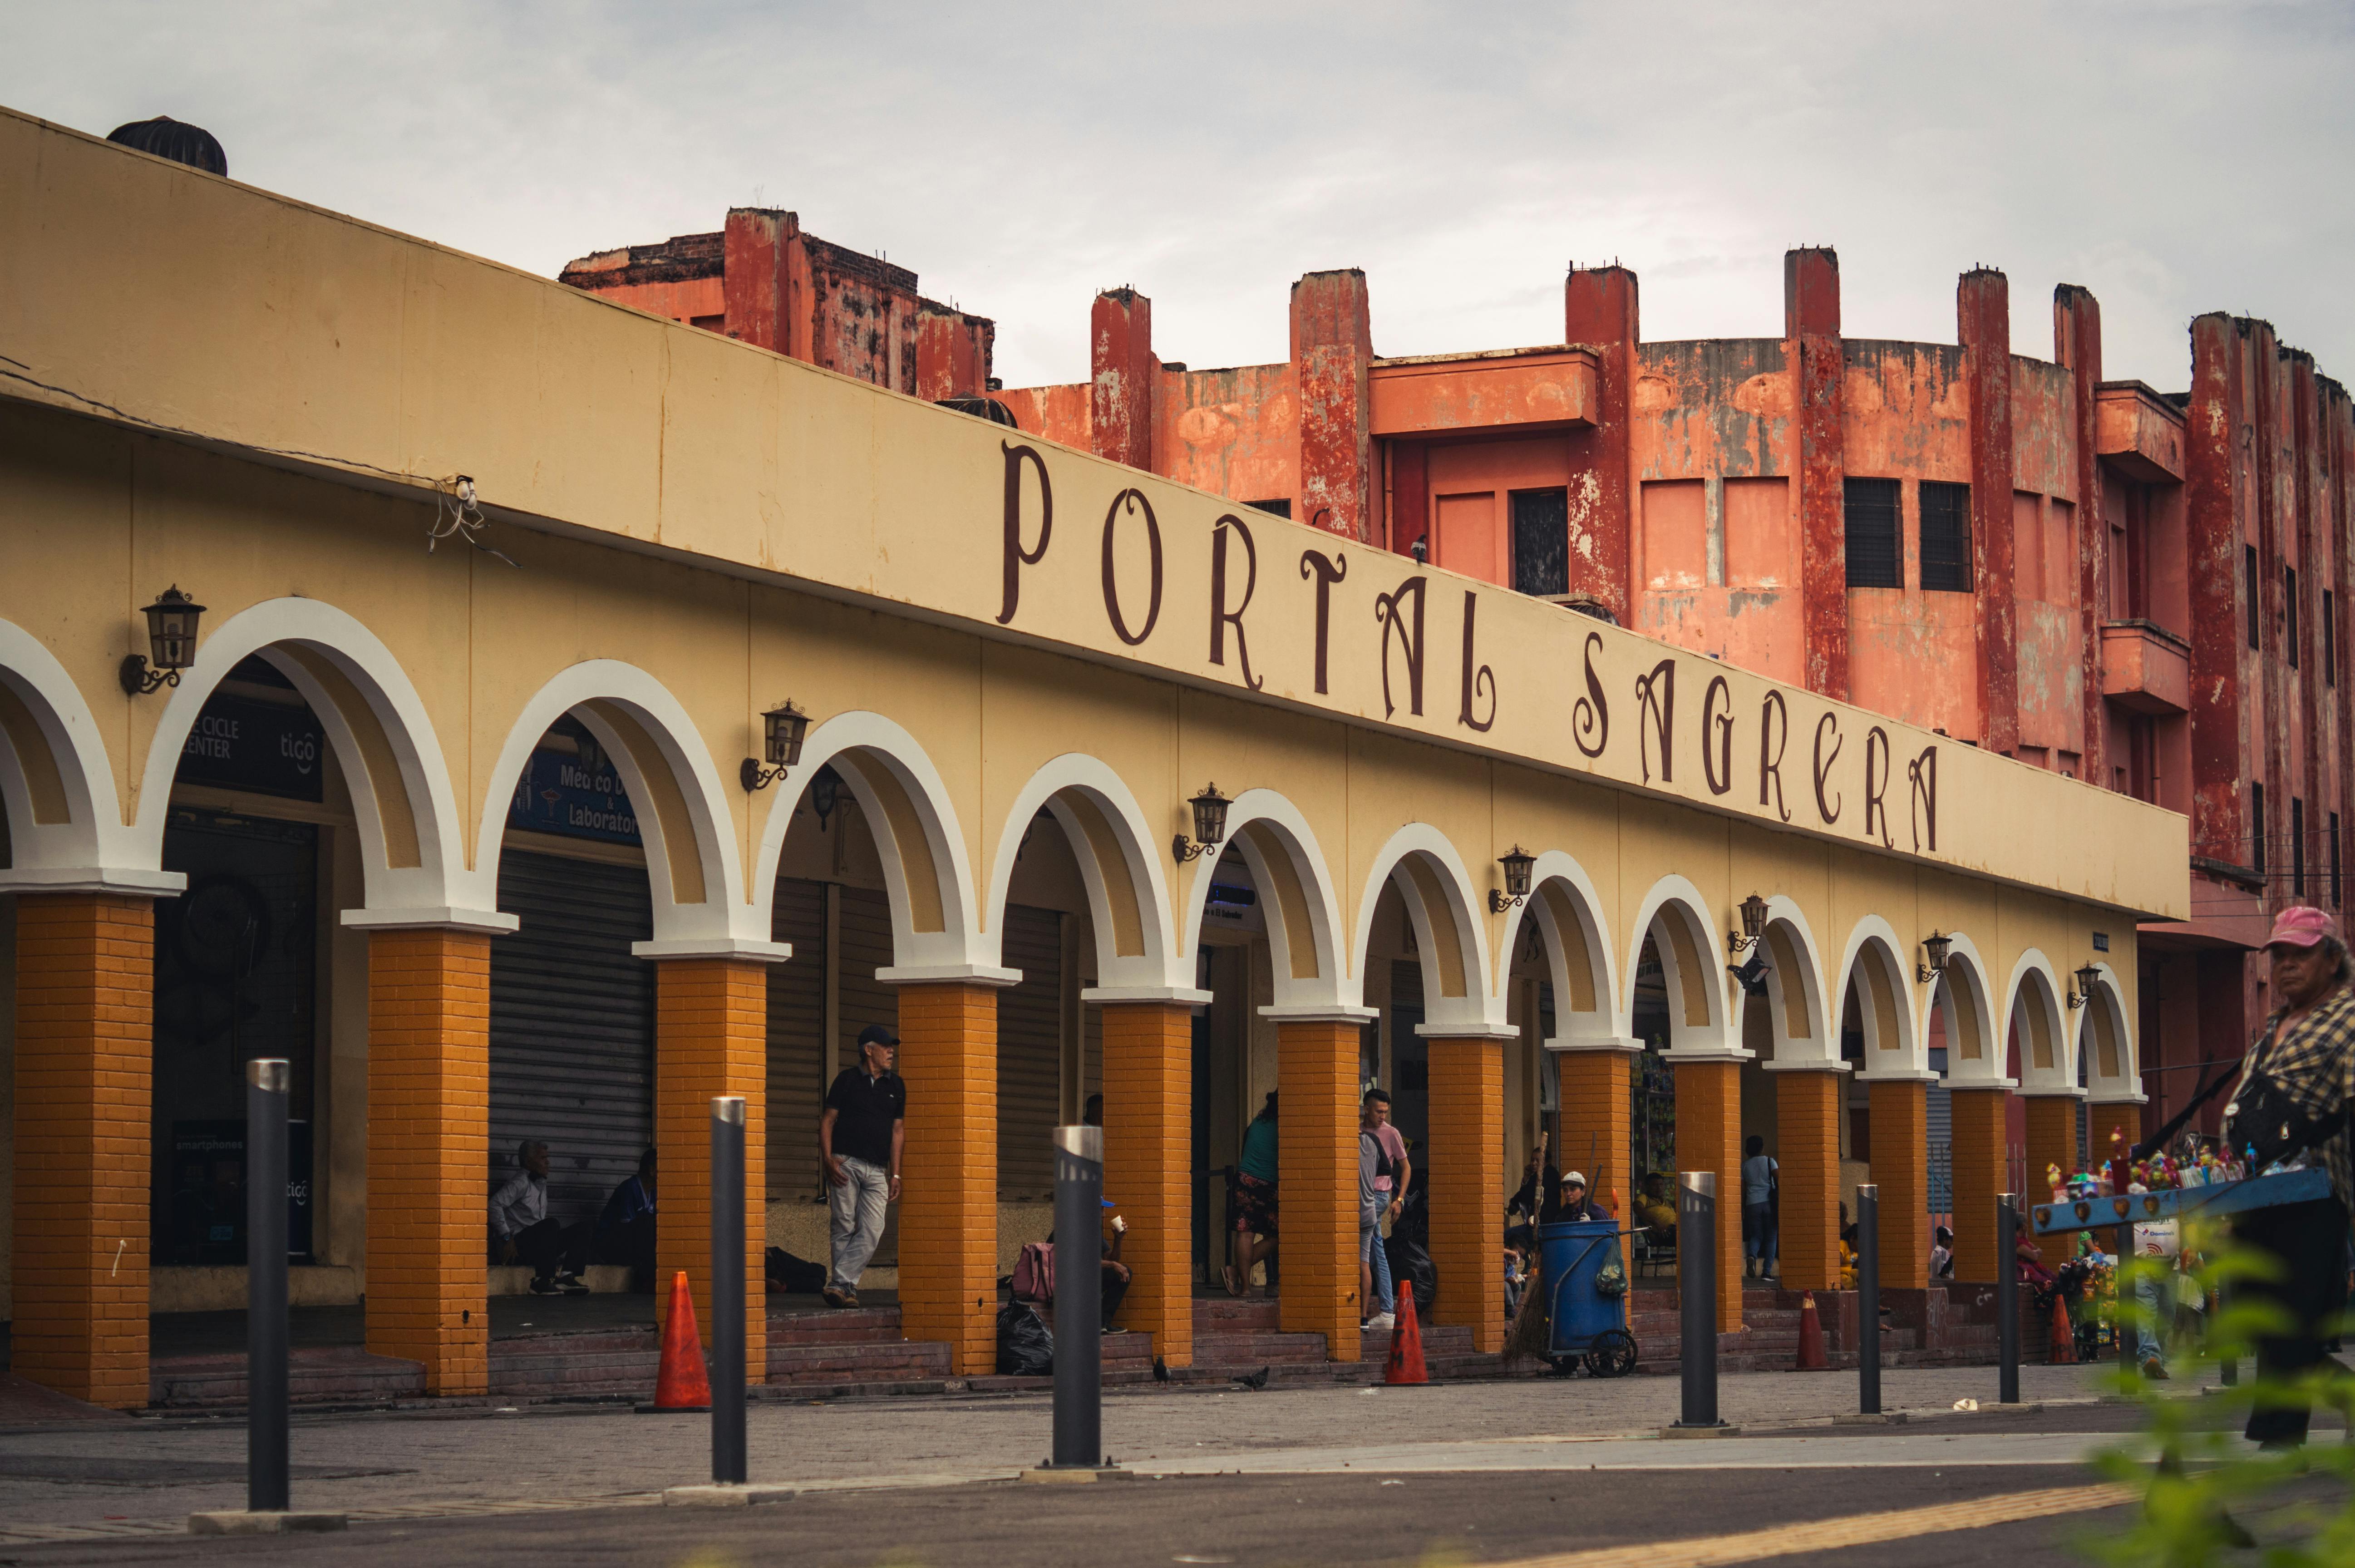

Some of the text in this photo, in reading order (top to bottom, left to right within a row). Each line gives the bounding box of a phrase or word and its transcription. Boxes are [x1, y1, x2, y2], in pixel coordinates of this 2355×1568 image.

[995, 438, 1938, 854] PORTAL SAGRERA
[202, 715, 239, 740] CICLE
[182, 735, 231, 759] ENTER
[606, 796, 614, 810] &
[569, 803, 640, 835] Laborator
[1222, 909, 1242, 920] Salvador
[176, 1140, 243, 1153] smartphones
